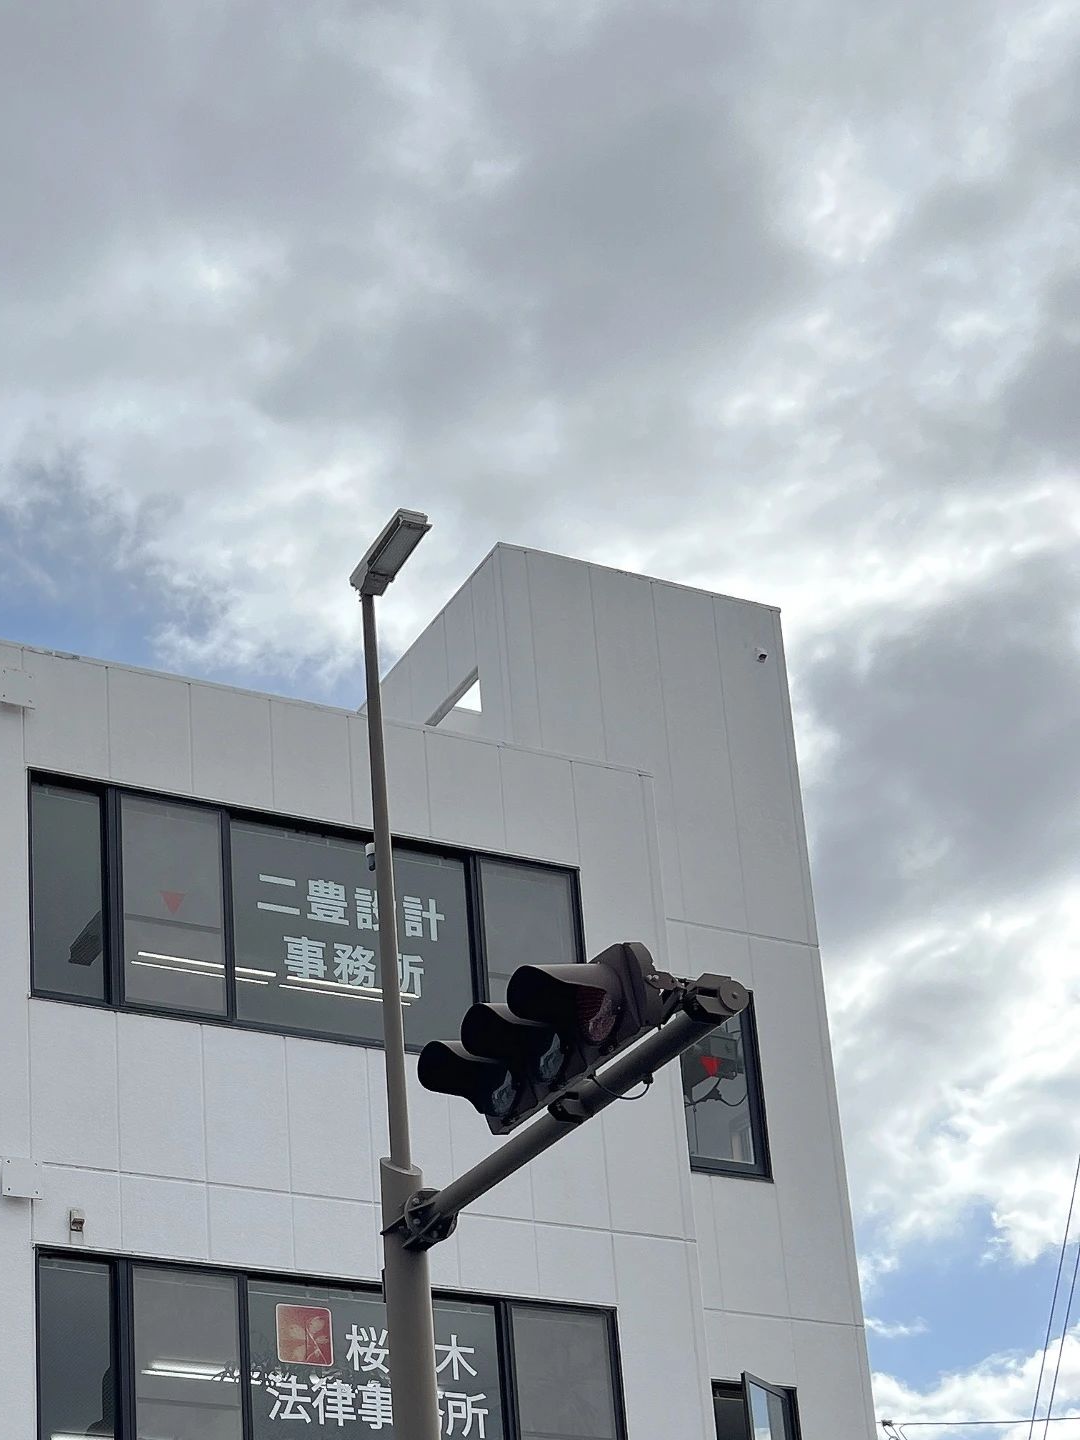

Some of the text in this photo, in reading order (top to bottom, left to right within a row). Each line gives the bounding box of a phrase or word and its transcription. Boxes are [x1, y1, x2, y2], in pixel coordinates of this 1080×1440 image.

[283, 936, 425, 998] 事務所
[345, 1324, 478, 1380] 桜木
[266, 1375, 489, 1438] 法律事所
